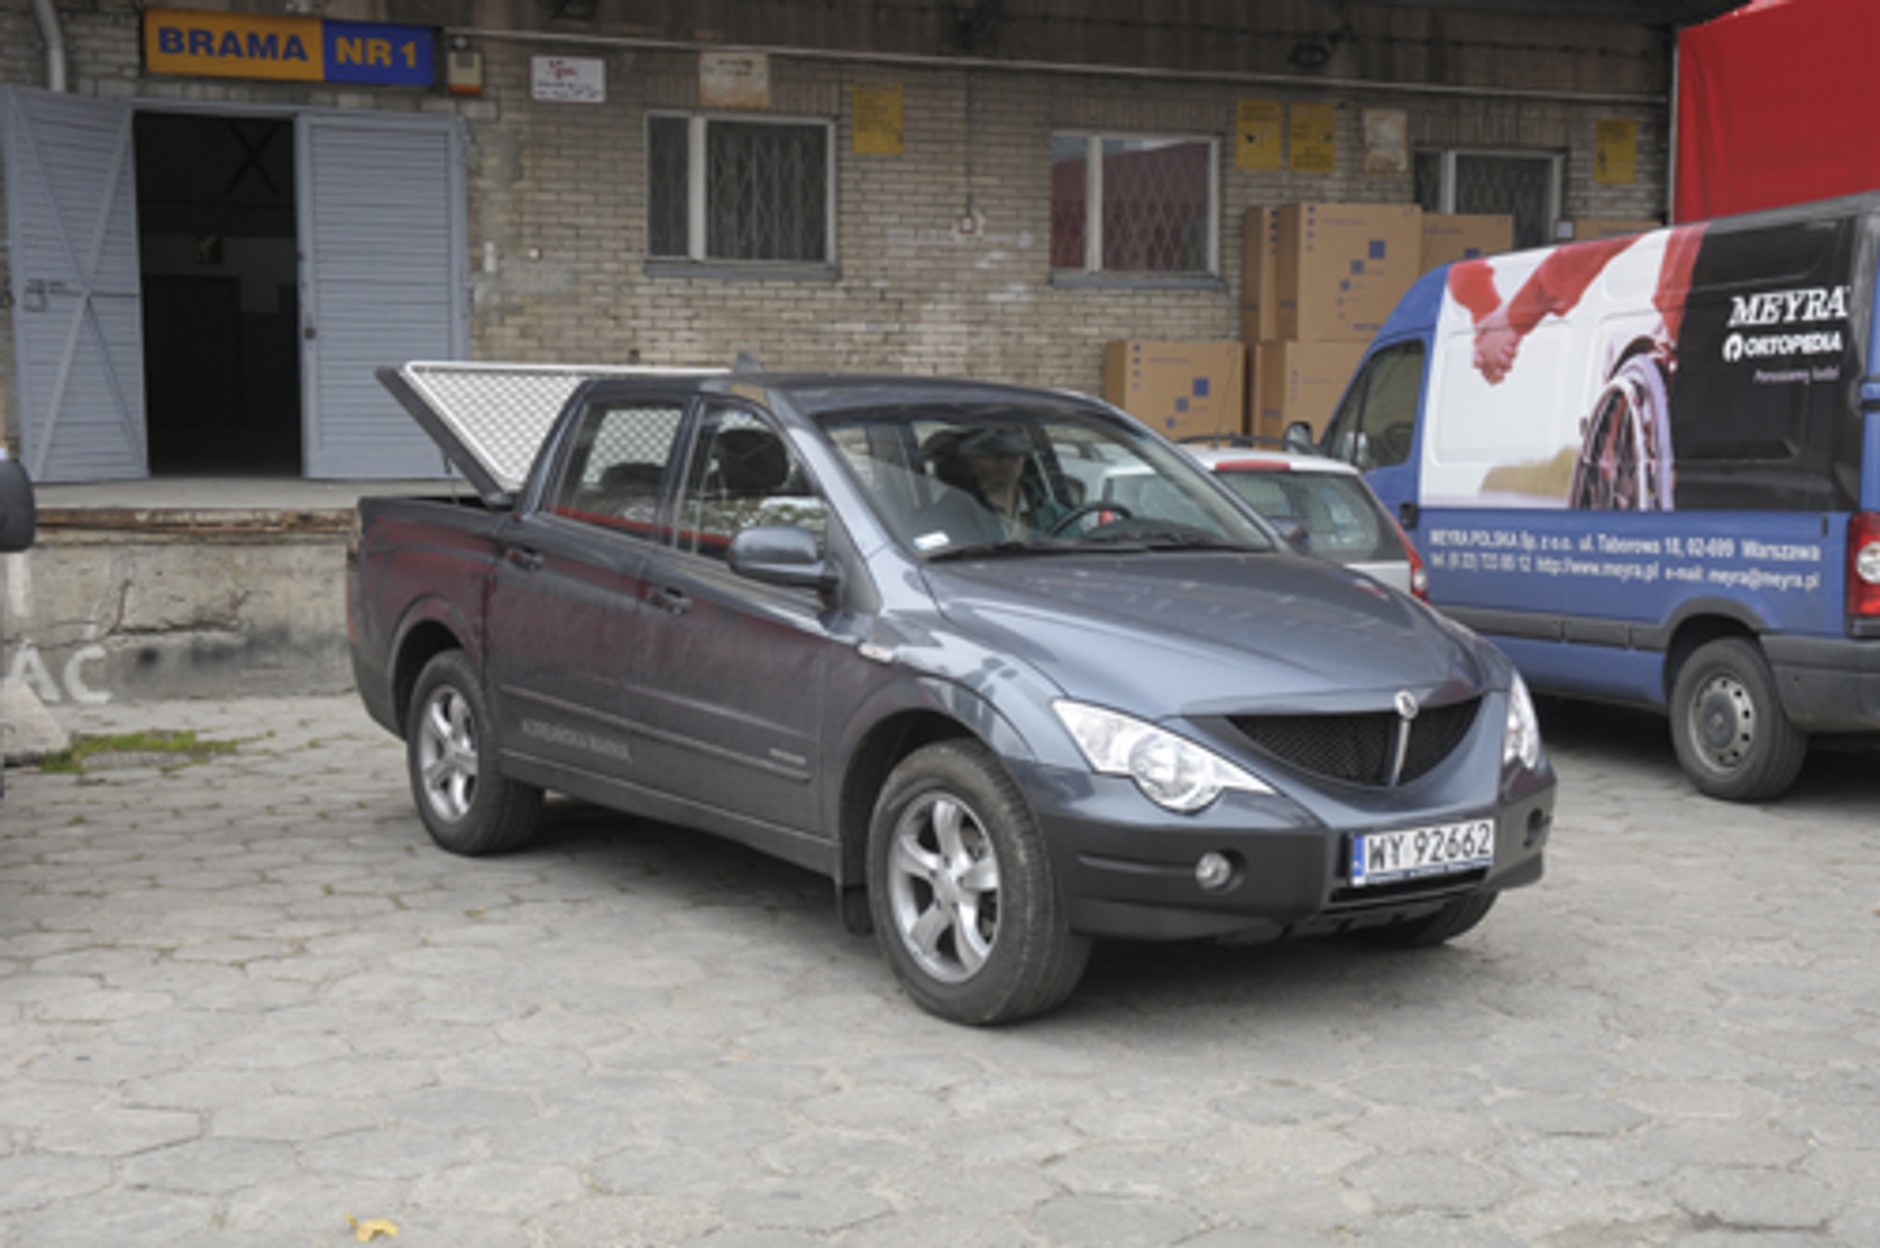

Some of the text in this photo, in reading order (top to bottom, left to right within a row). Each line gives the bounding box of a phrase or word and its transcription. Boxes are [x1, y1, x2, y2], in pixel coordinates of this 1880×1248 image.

[157, 26, 416, 68] BRAMA NR 1
[1726, 284, 1849, 328] MEYRA
[1744, 331, 1843, 358] ORTOPEDIA
[1740, 538, 1821, 562] Warszawa
[1368, 823, 1491, 870] WY 92662
